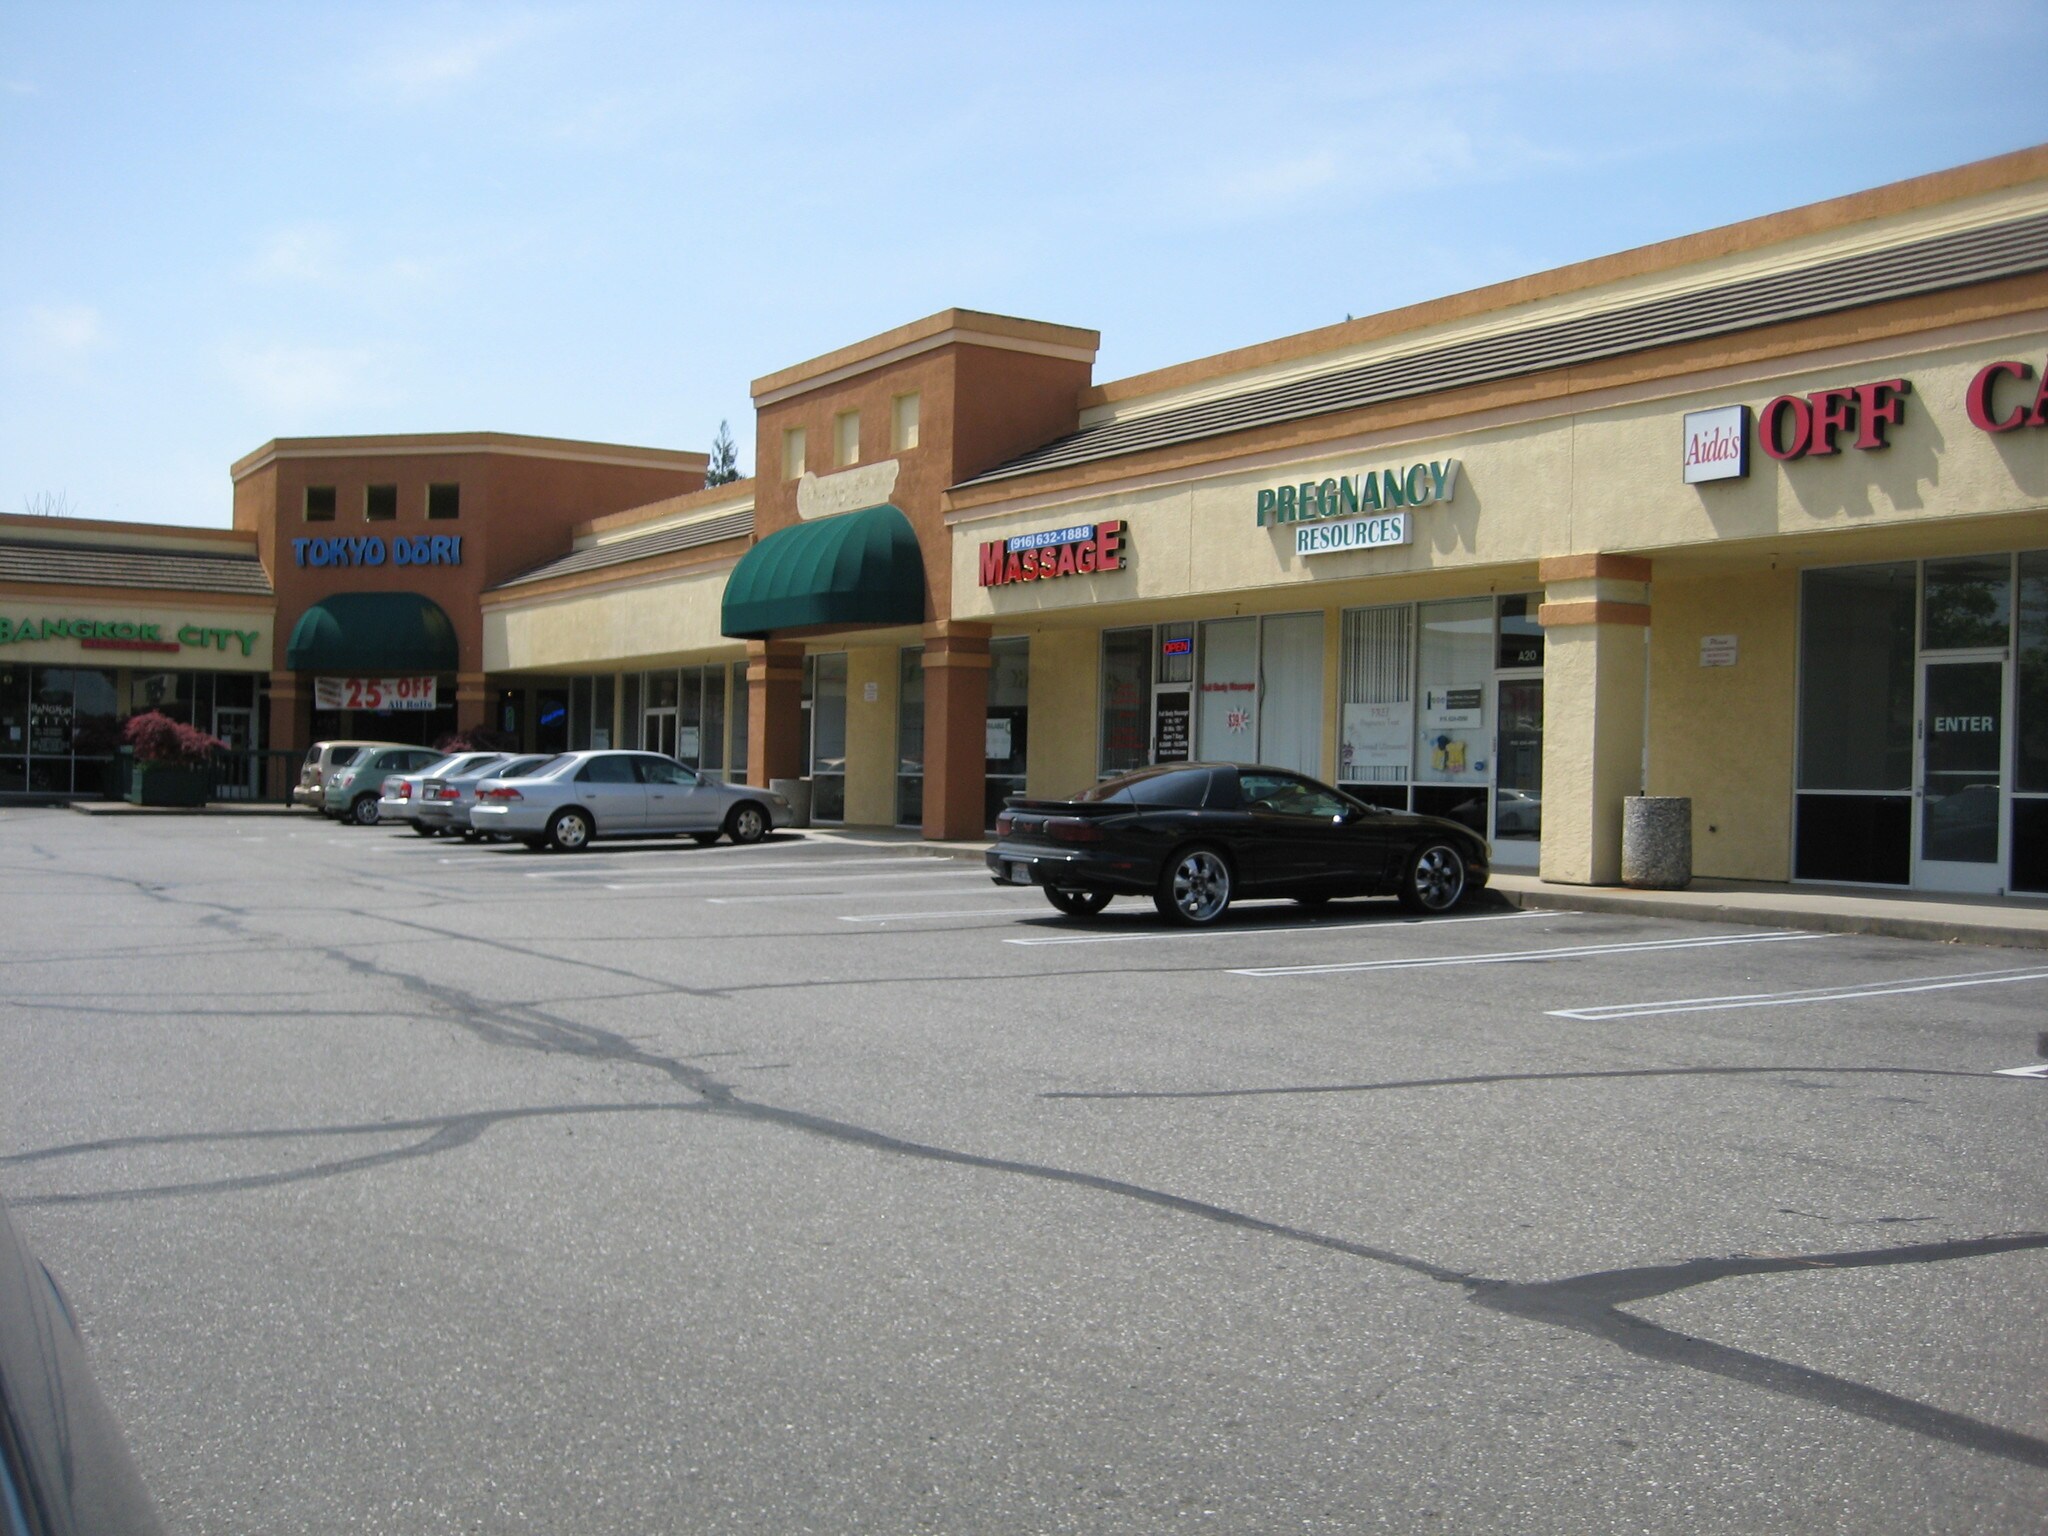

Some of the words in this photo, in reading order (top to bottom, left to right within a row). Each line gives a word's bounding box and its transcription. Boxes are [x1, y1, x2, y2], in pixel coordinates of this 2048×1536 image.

[1684, 426, 1740, 466] Aida's
[1758, 378, 1911, 461] OFF
[1256, 458, 1459, 527] PREGNANCY
[1010, 535, 1035, 550] (916)
[1036, 525, 1090, 545] 632-1888
[1297, 517, 1402, 552] RESOURCES
[292, 536, 387, 567] TOKYO
[978, 520, 1125, 587] MASSAGE
[0, 616, 162, 645] BANGKOK
[178, 624, 260, 657] CITY
[1164, 641, 1188, 654] OPEN
[1517, 649, 1537, 661] A20
[397, 677, 432, 698] OFF
[31, 703, 73, 716] BANGKOK
[1934, 716, 1994, 733] ENTER
